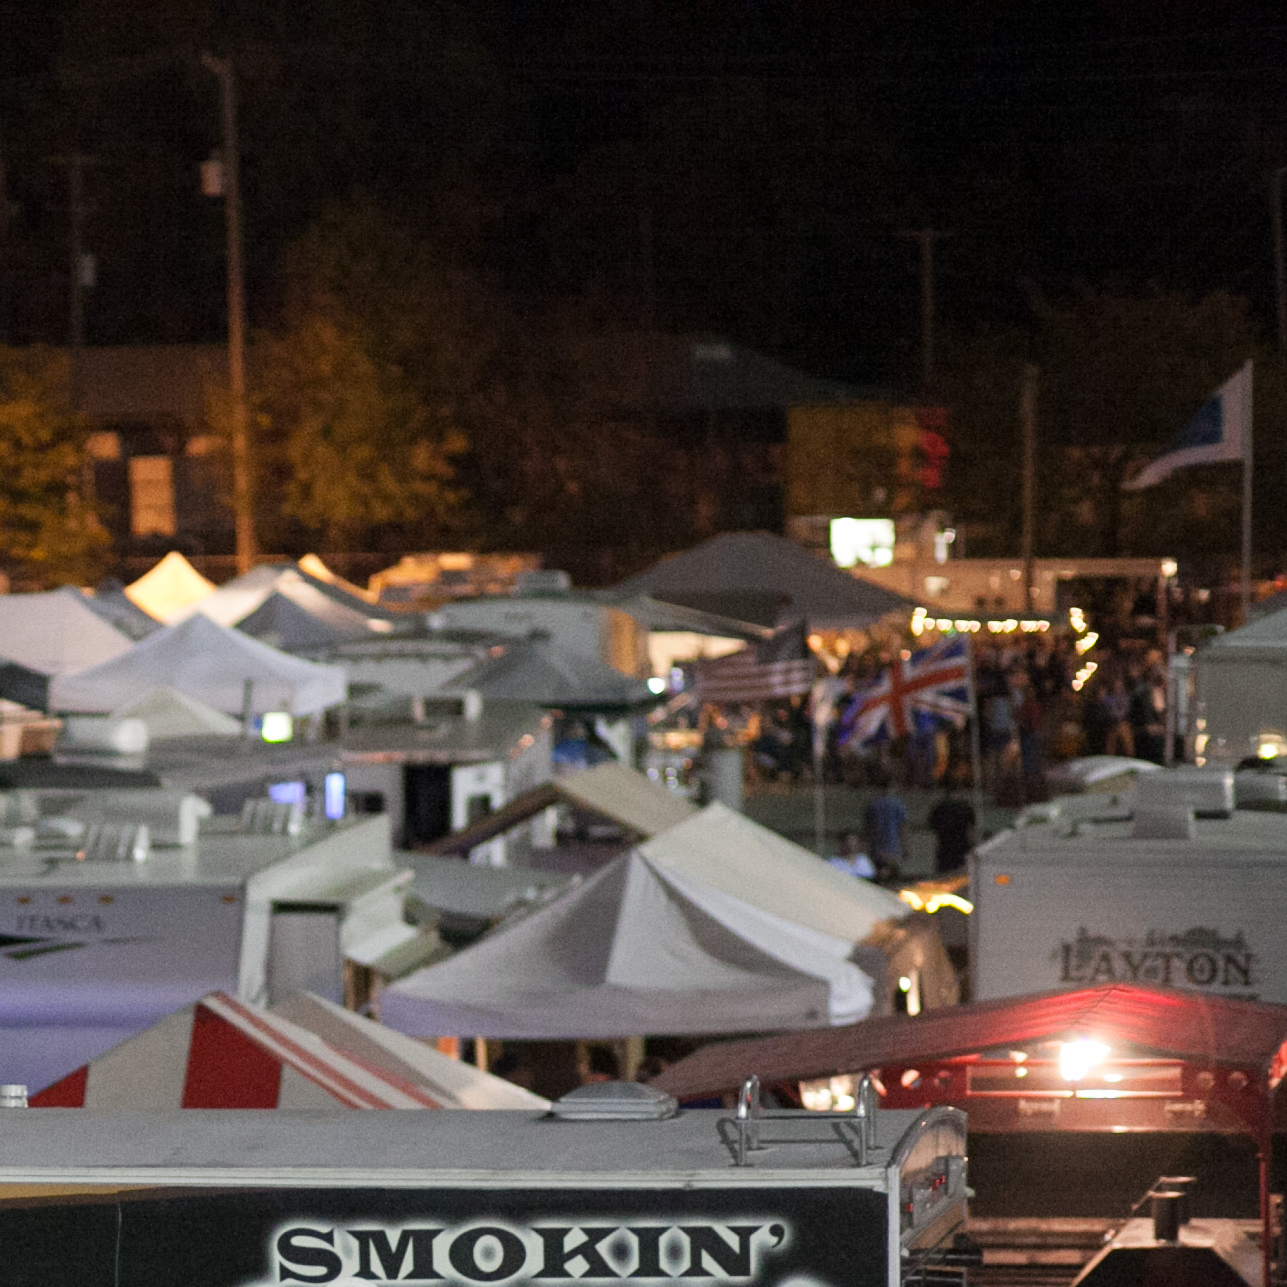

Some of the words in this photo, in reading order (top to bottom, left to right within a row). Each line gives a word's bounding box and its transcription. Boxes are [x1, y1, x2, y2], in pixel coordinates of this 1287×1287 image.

[17, 913, 105, 932] ITASCA
[1059, 941, 1256, 986] LAYTON
[276, 1222, 786, 1284] SMOKIN'
